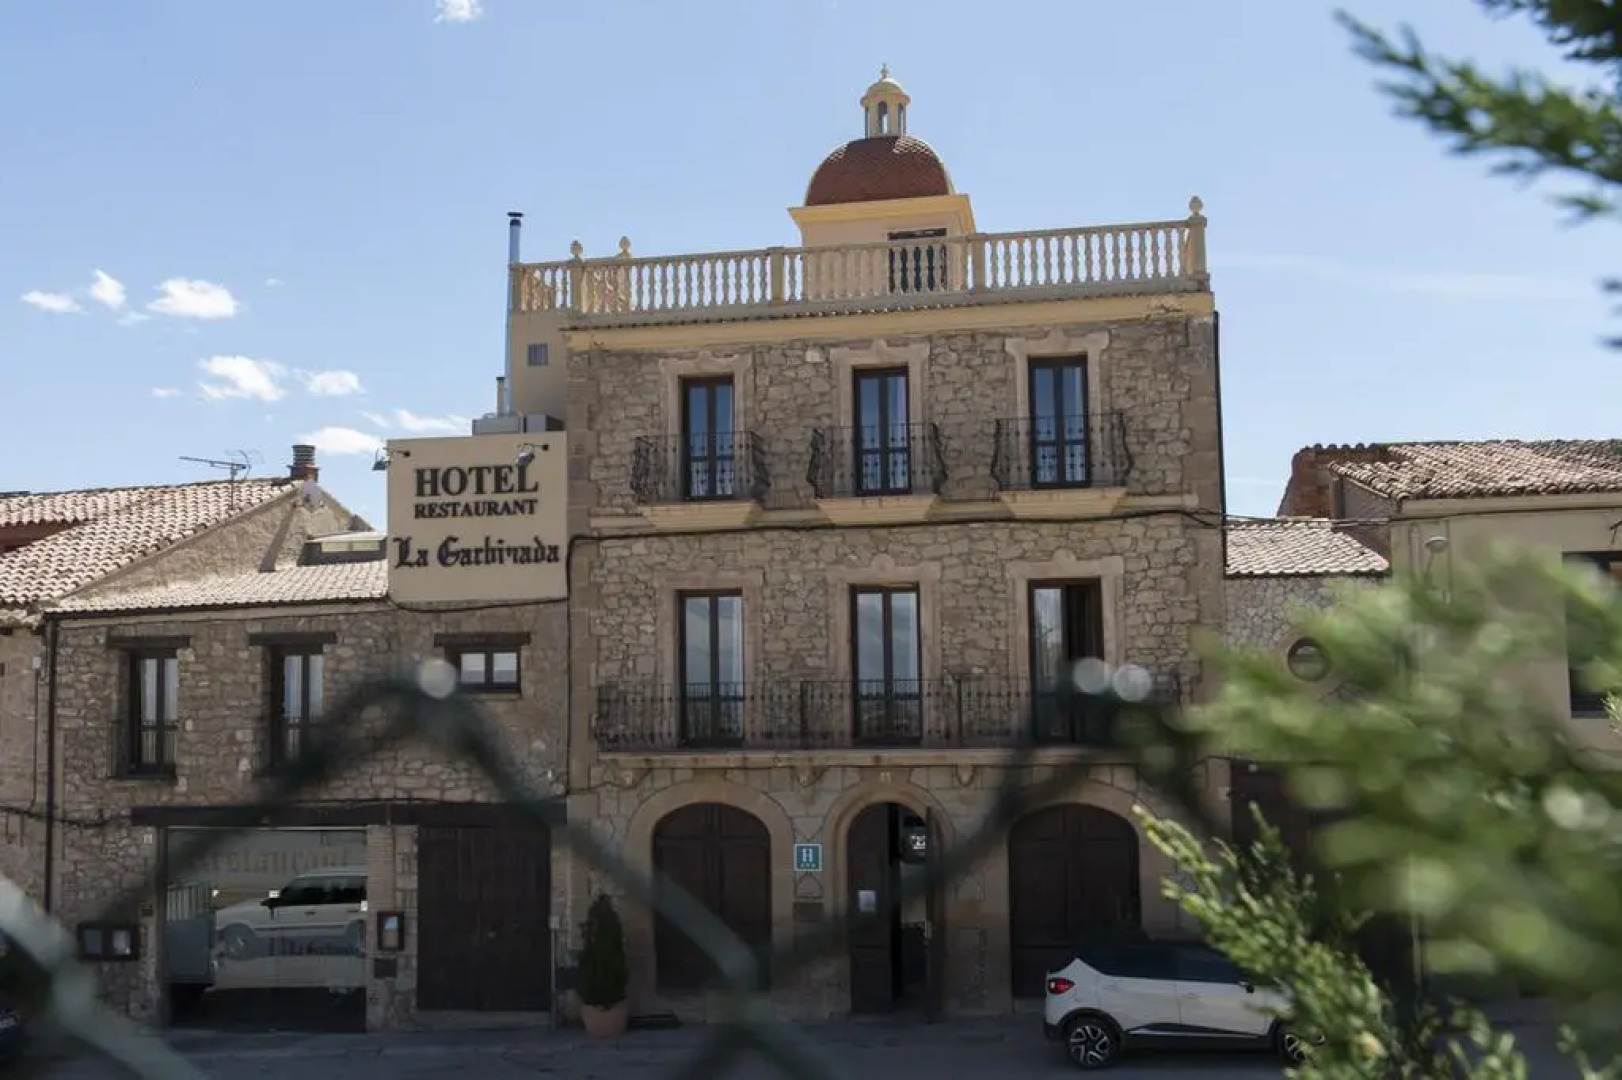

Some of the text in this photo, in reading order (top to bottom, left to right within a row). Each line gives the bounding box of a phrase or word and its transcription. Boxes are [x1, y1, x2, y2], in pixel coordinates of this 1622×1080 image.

[415, 464, 539, 497] HOTEL
[414, 499, 538, 519] RESTAURANT
[393, 535, 559, 569] La Garbinada
[802, 848, 814, 862] H
